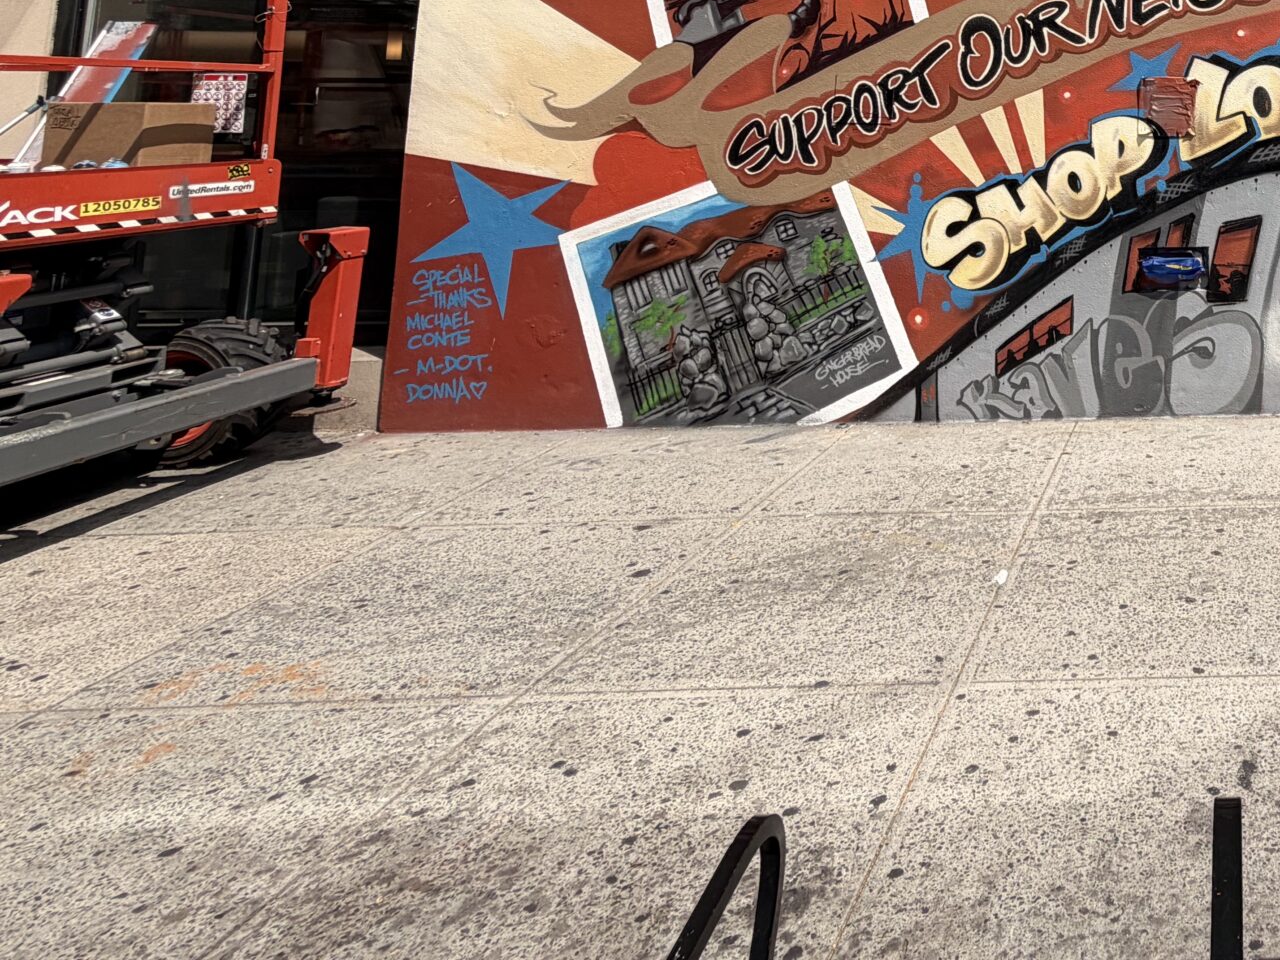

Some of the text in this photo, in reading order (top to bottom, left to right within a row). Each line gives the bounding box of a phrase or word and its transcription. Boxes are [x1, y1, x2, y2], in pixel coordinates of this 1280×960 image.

[727, 40, 953, 175] SUPPORT
[171, 184, 252, 197] UntedRentals.com
[920, 114, 1157, 292] SHOP
[0, 197, 160, 228] ACK 12050785
[412, 263, 485, 296] SPECIAL
[420, 288, 492, 310] THANKS
[406, 310, 474, 332] MICHAEL
[407, 329, 471, 351] CONTE
[406, 377, 471, 404] DONNA
